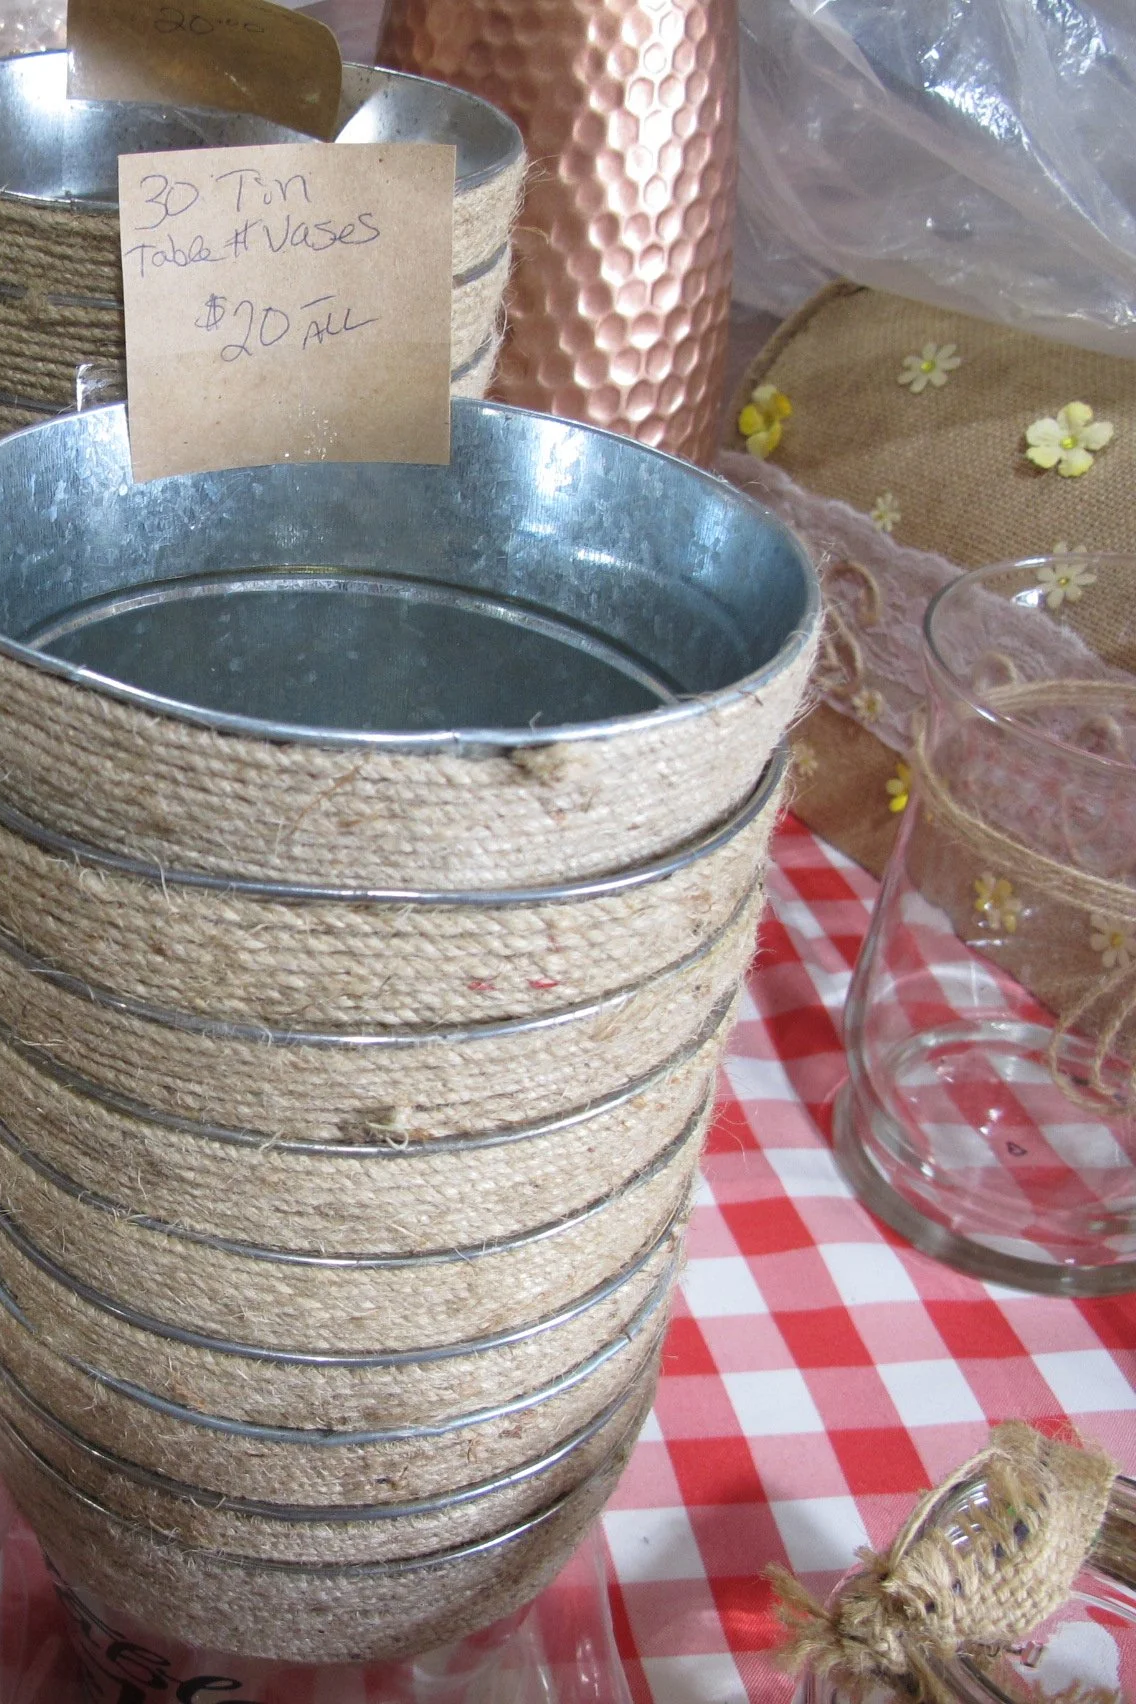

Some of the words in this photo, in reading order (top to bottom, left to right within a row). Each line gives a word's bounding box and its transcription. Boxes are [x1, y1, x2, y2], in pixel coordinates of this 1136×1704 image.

[134, 174, 199, 231] 30
[215, 168, 311, 212] Tin
[124, 234, 227, 278] Table
[264, 212, 380, 253] Vases
